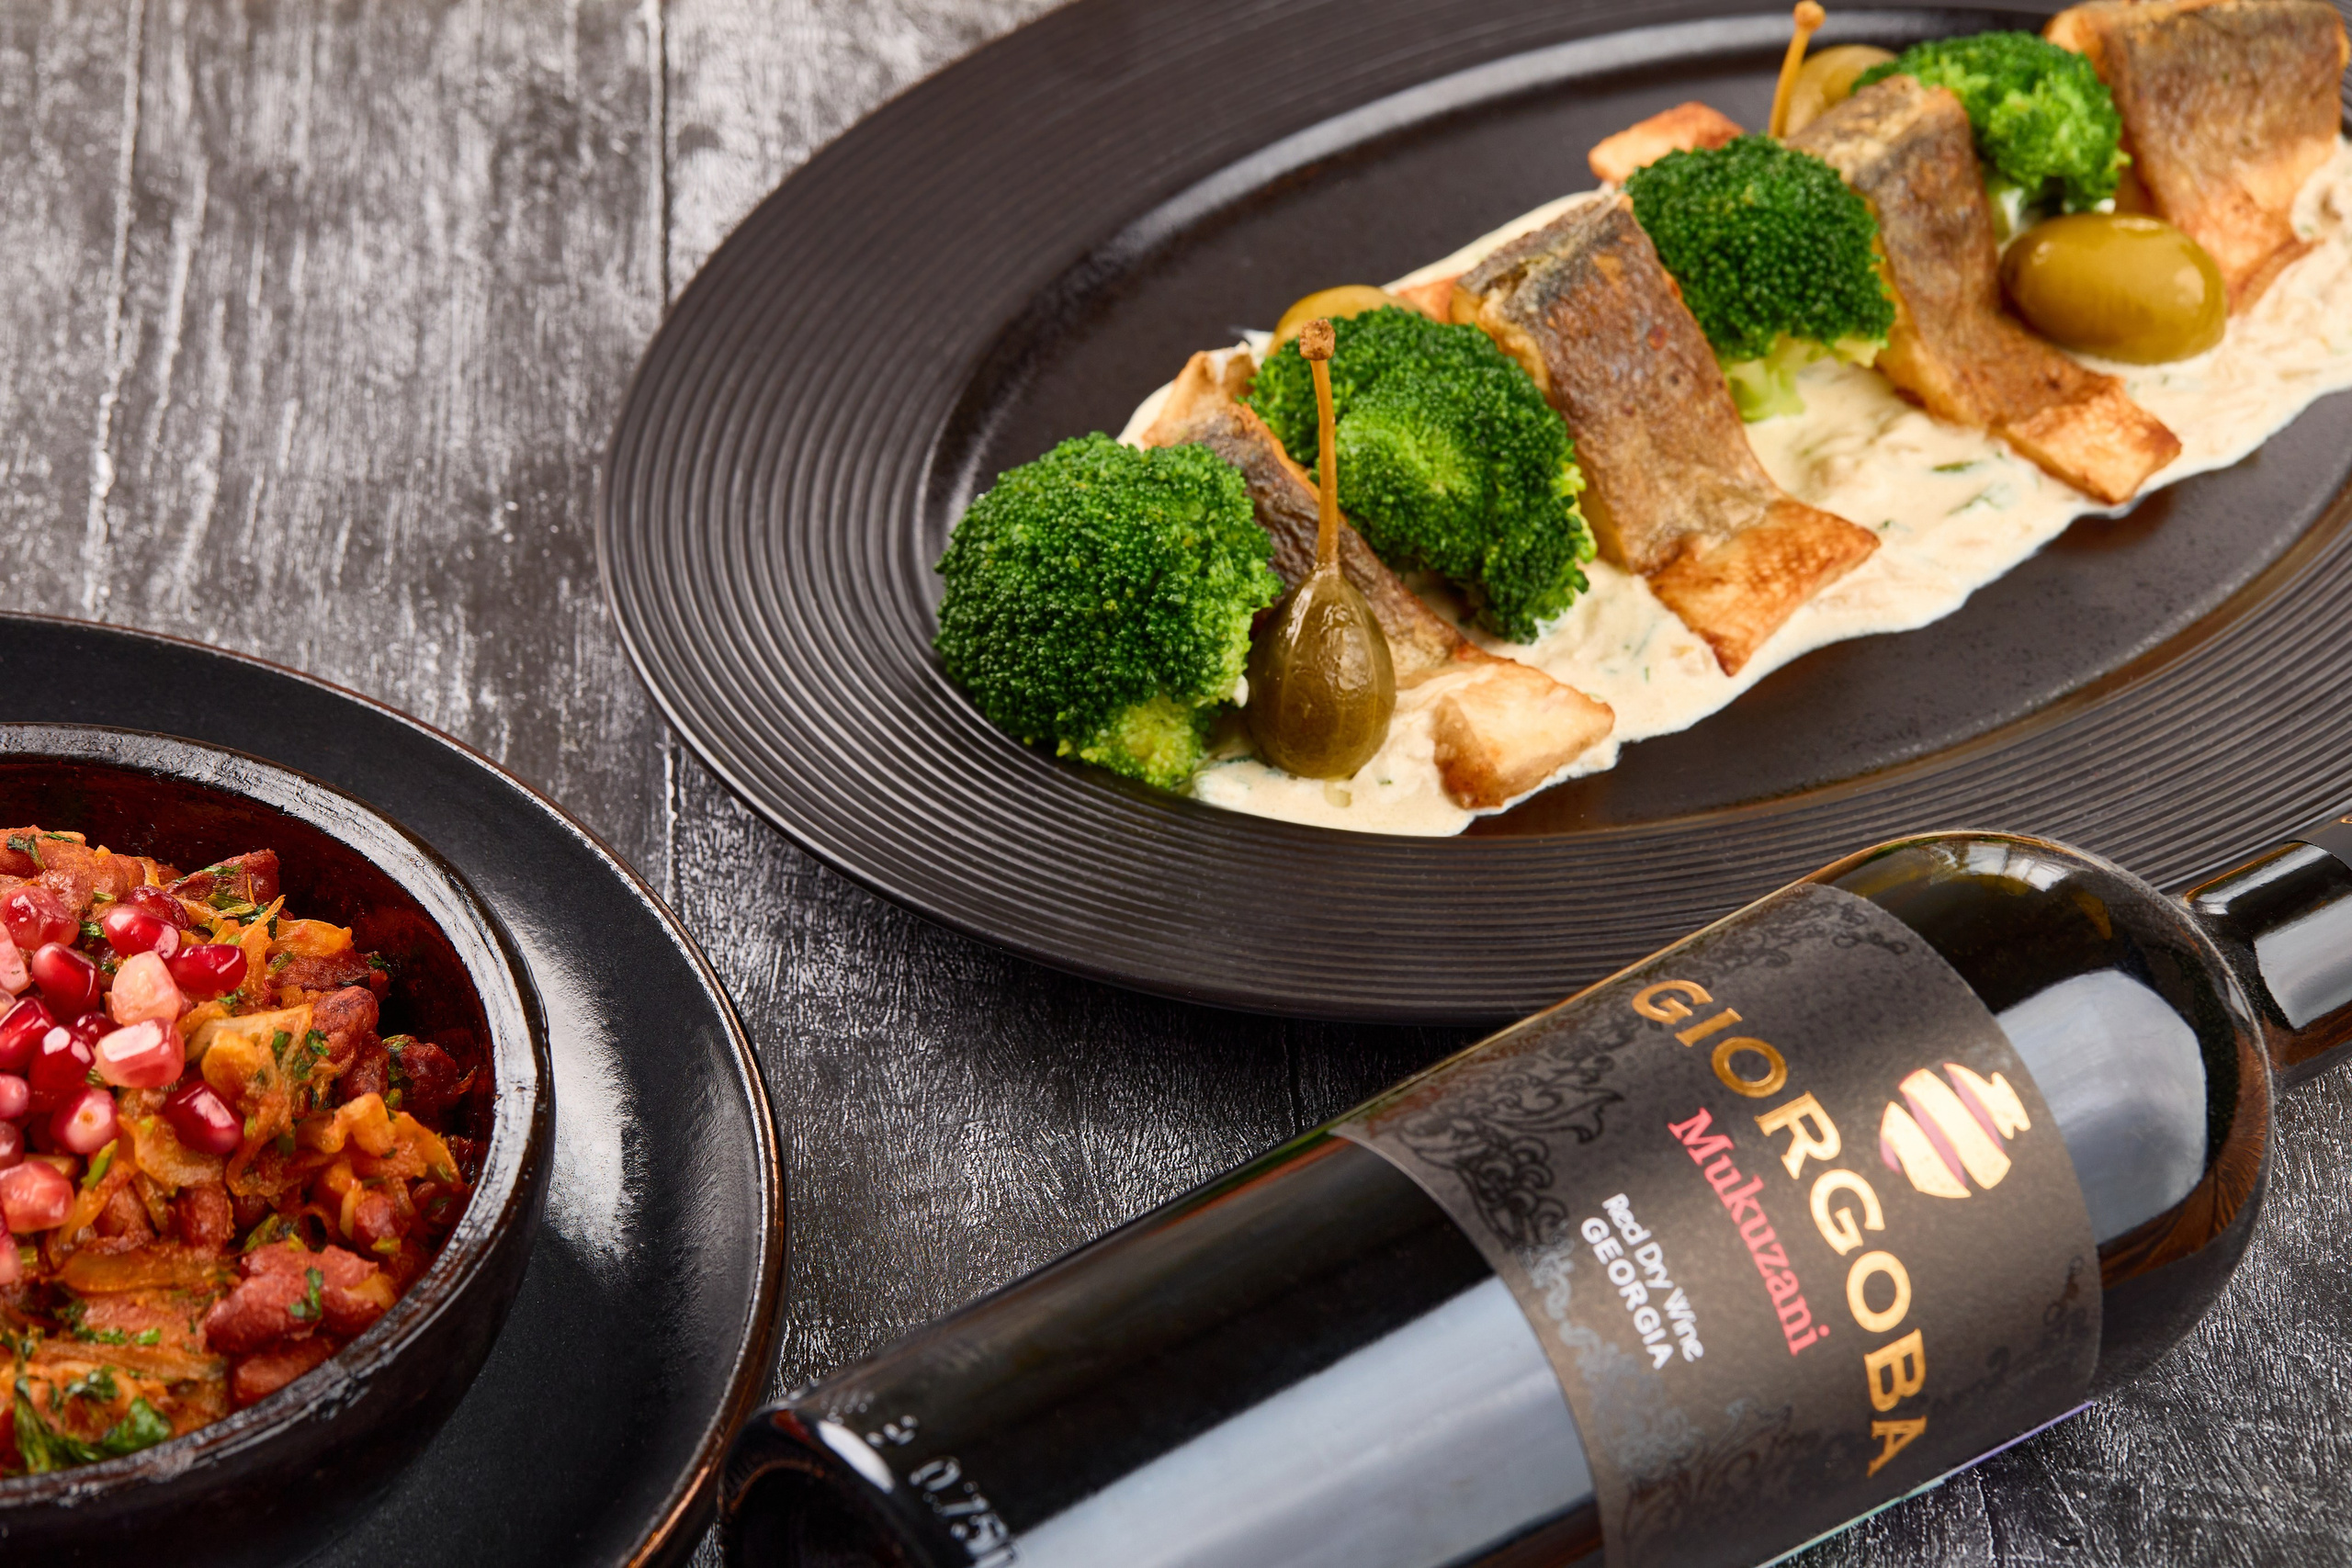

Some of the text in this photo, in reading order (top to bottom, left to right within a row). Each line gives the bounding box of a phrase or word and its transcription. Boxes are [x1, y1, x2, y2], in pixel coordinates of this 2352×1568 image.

[1580, 1217, 1674, 1370] GEORGIA
[1601, 1192, 1704, 1363] Red Dry Wine
[1632, 979, 1927, 1478] GIORGOBA
[1668, 1108, 1830, 1356] Mukuzani
